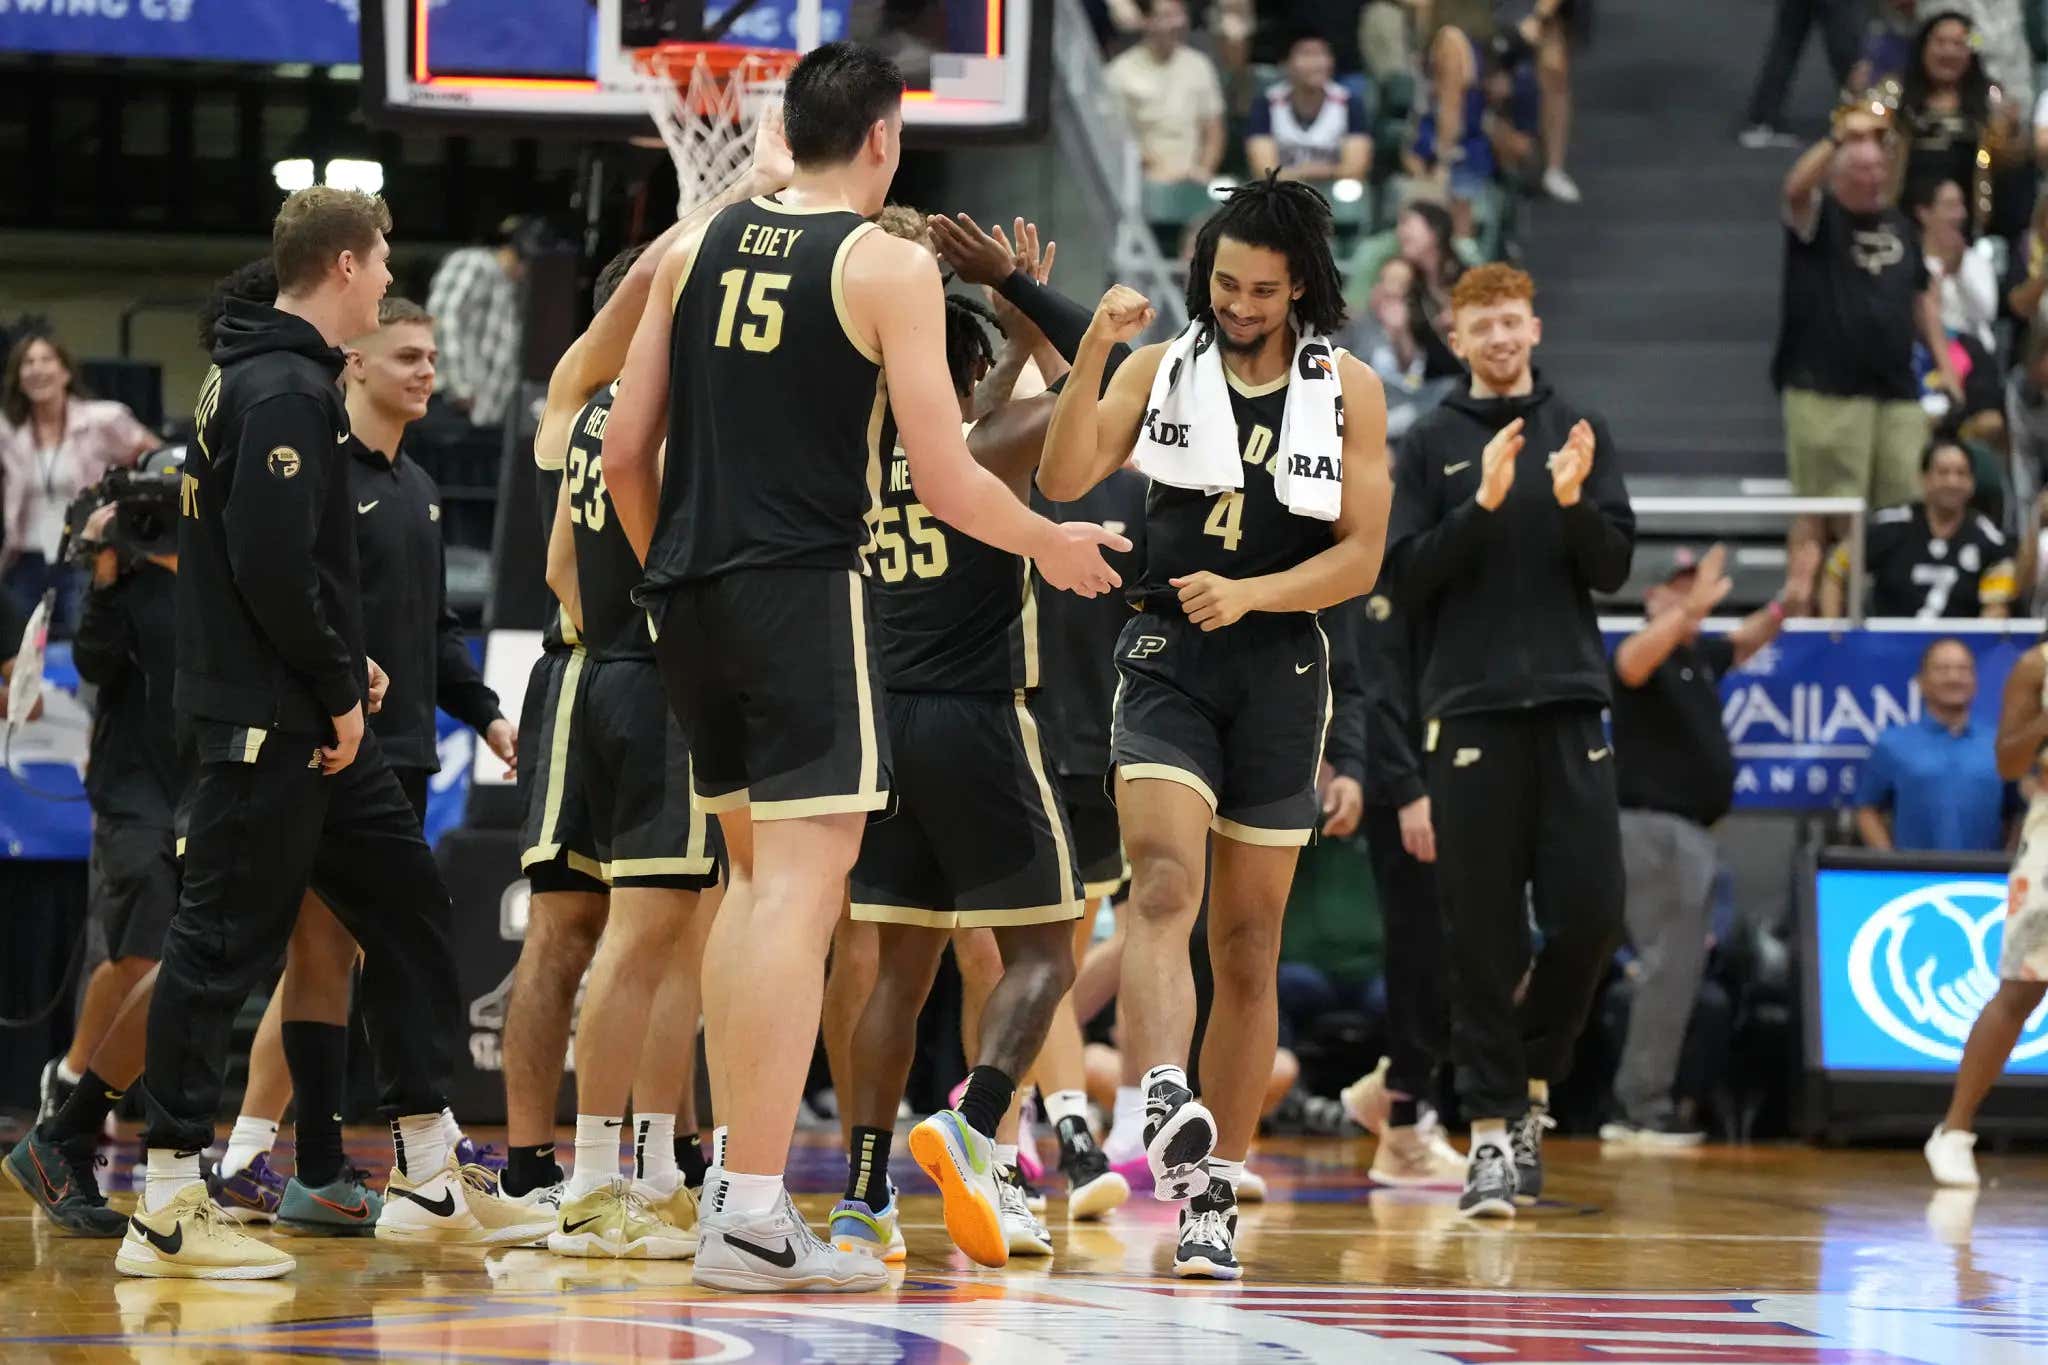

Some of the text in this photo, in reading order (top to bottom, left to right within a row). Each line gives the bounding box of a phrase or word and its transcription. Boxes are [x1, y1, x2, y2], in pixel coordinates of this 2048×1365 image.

[738, 223, 804, 258] EDEY
[715, 268, 791, 353] 15
[583, 405, 610, 440] HEI
[568, 446, 607, 532] 23
[888, 459, 912, 492] NE
[1288, 453, 1342, 482] RA
[875, 503, 949, 583] 55
[1203, 491, 1244, 551] 4
[1911, 563, 1959, 622] 7
[1127, 635, 1167, 659] P
